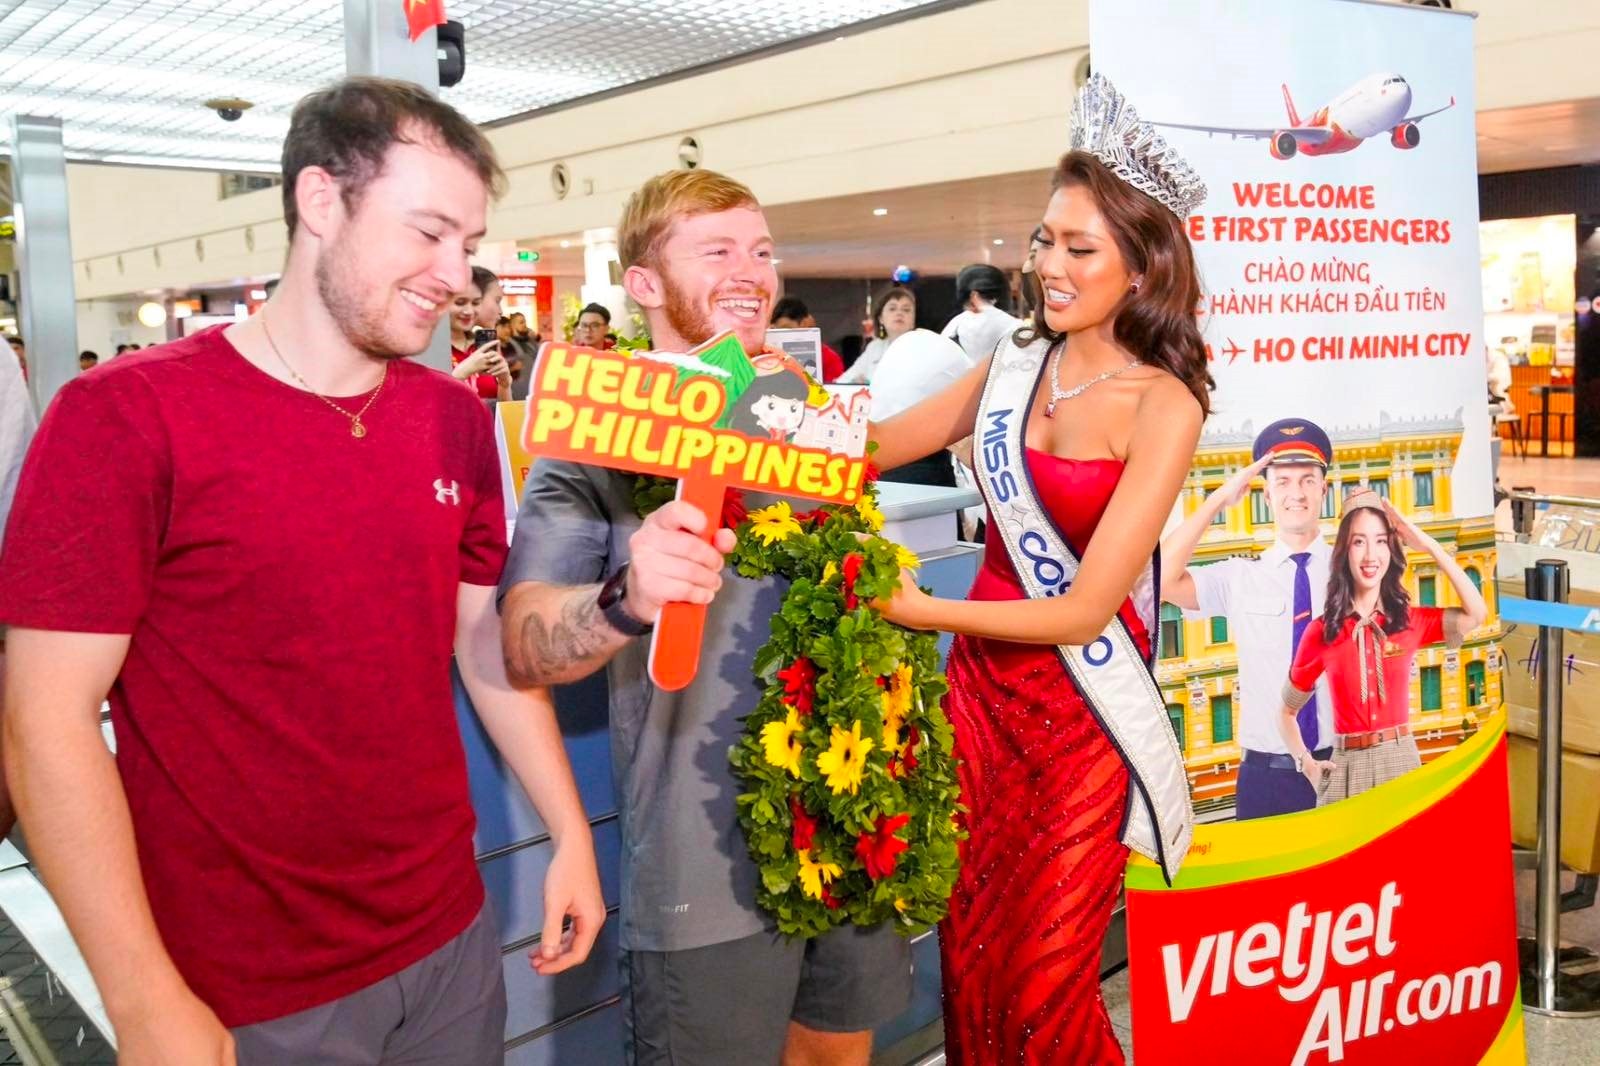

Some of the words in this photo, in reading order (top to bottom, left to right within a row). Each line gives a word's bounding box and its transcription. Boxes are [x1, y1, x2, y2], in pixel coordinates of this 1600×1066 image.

[1232, 182, 1376, 209] WELCOME
[1212, 216, 1287, 242] FIRST
[1294, 217, 1451, 245] PASSENGERS
[1244, 255, 1305, 283] CHÀO
[1310, 255, 1370, 284] MỪNG
[1211, 288, 1273, 314] HÀNH
[1281, 287, 1348, 313] KHÁCH
[1354, 284, 1399, 312] ĐẦU
[1404, 286, 1446, 311] TIÊN
[1253, 338, 1295, 363] HO
[1302, 336, 1344, 361] CHI
[1349, 334, 1418, 360] MINH
[1424, 332, 1471, 357] CITY
[541, 348, 721, 423] HELLO
[531, 398, 864, 501] PHILIPPINES!
[983, 408, 1019, 503] MISS
[1187, 842, 1212, 856] ying!
